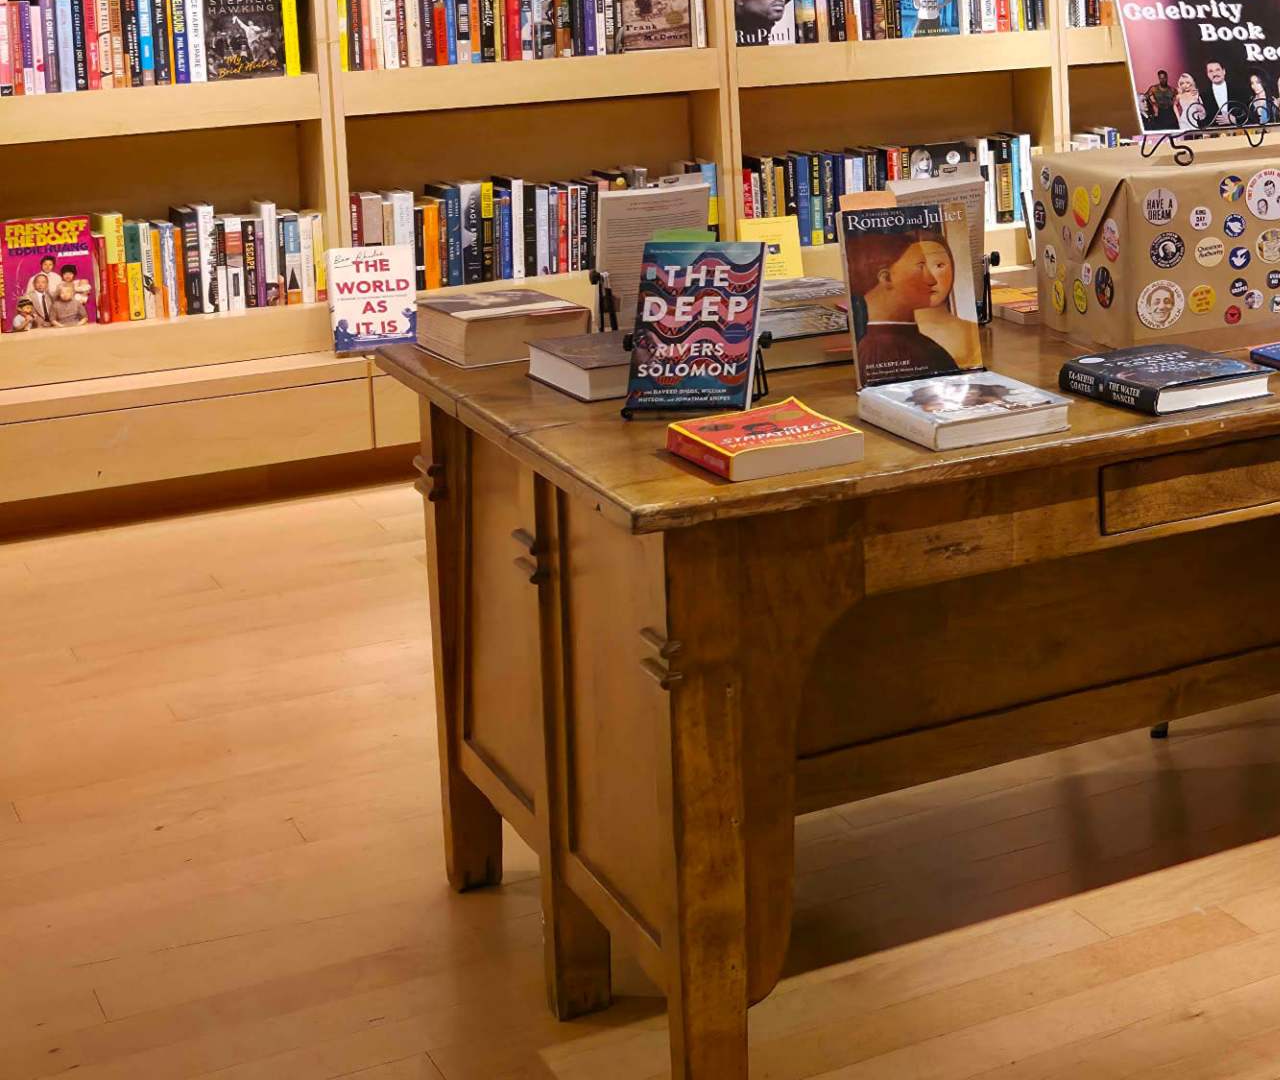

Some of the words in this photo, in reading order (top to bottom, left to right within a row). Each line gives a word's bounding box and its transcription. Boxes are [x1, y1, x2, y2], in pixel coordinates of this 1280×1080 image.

[208, 2, 274, 15] HAWKING
[626, 23, 657, 32] Frank
[735, 27, 791, 44] RuPaul
[1198, 22, 1266, 42] Book
[1146, 199, 1165, 210] HAVE
[1168, 199, 1173, 209] A
[847, 214, 905, 231] Romeo
[906, 214, 923, 226] and
[922, 208, 963, 229] Juliet
[1147, 209, 1173, 221] DREAM
[6, 221, 56, 237] FRESH
[57, 219, 88, 231] OFF
[35, 230, 80, 248] BOAT
[351, 259, 390, 273] THE
[663, 265, 731, 288] THE
[335, 279, 409, 296] WORLD
[361, 300, 387, 314] AS
[643, 296, 749, 322] DEEP
[355, 322, 373, 335] IT
[380, 321, 398, 334] IS
[653, 341, 726, 357] RIVERS
[637, 361, 737, 377] SOLOMON
[1119, 385, 1141, 398] WATER
